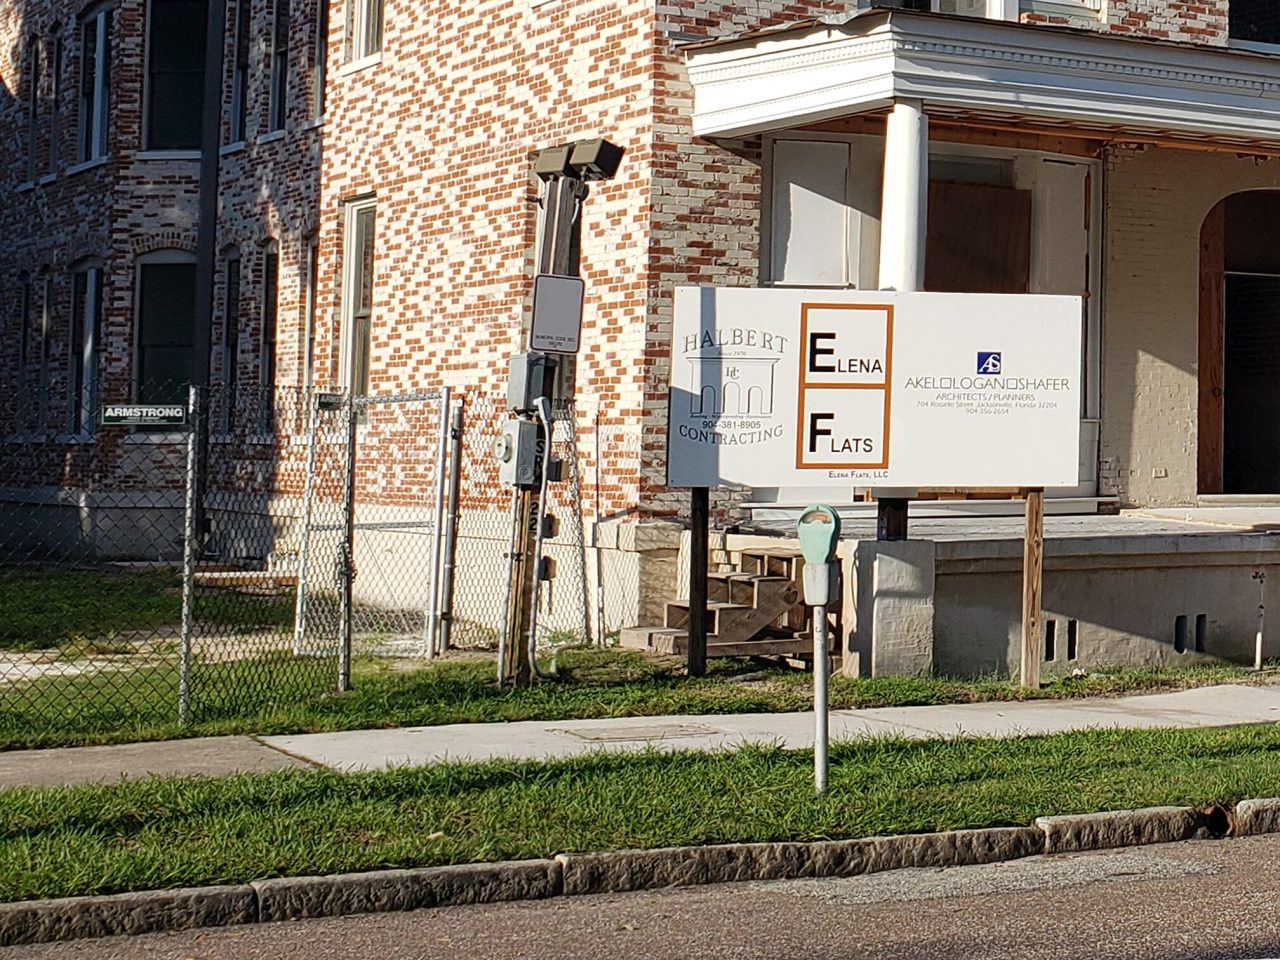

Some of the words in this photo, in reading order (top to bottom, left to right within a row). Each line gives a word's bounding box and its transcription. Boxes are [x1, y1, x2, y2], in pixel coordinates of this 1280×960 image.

[682, 328, 788, 354] HALBERT
[809, 332, 883, 373] ELENA
[105, 407, 183, 417] ARMSTRONG
[679, 424, 784, 446] CONTRACTING
[702, 420, 762, 429] 904-381-8905
[809, 413, 874, 453] FLATS
[873, 470, 889, 478] LLC
